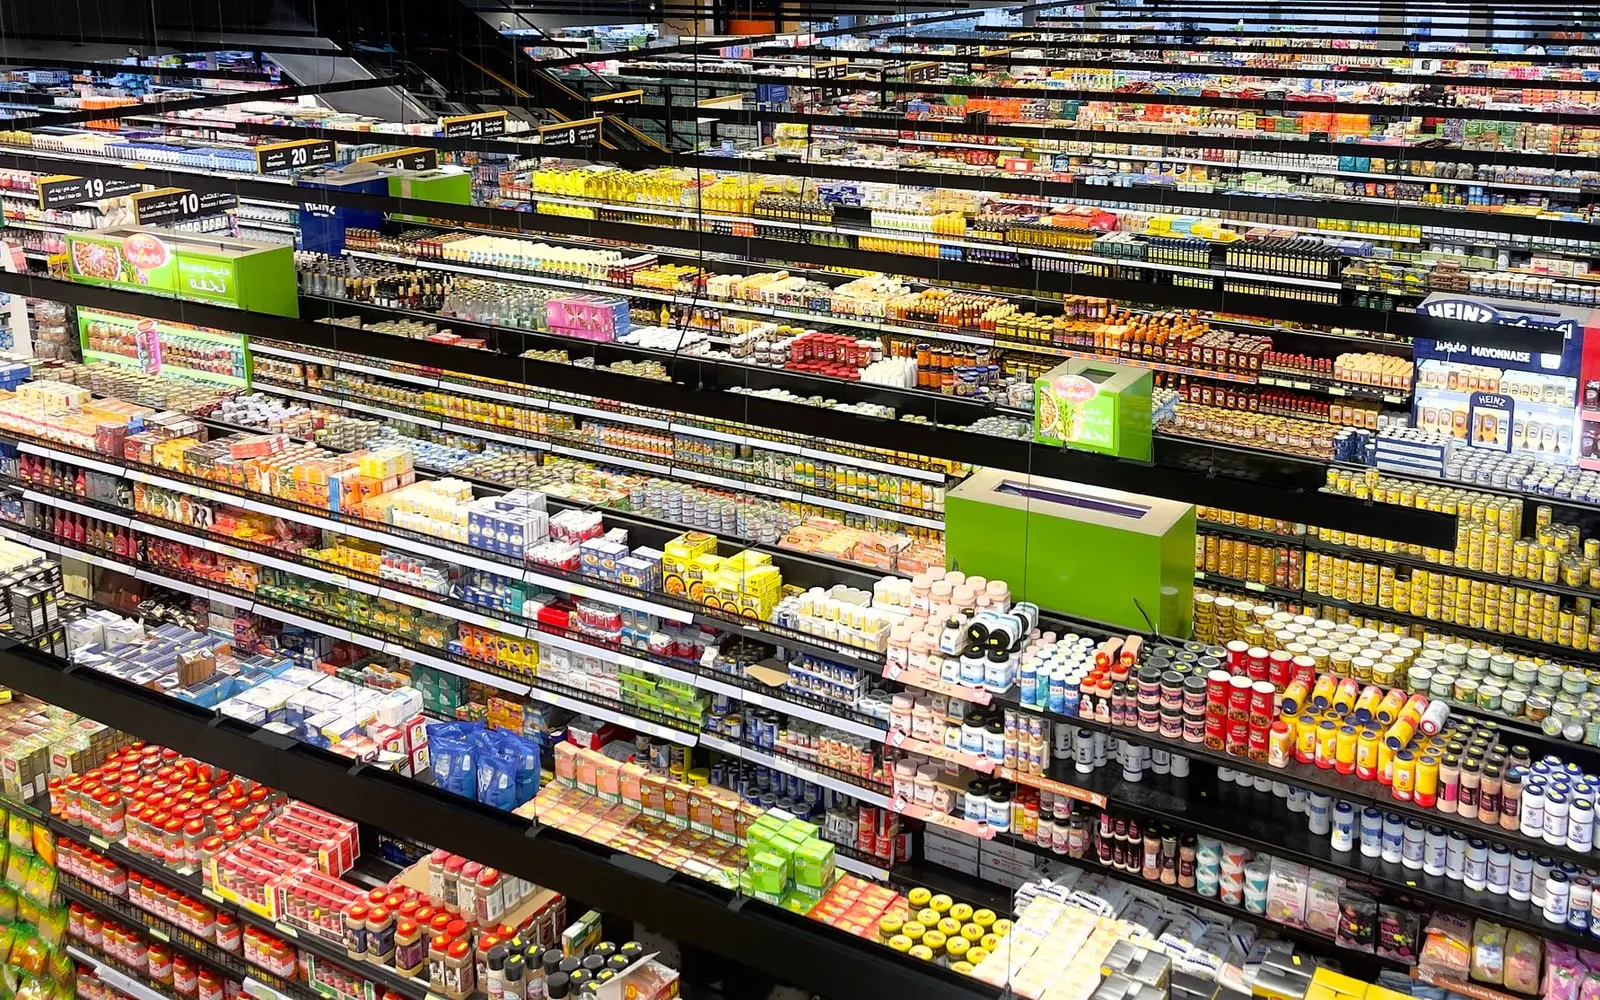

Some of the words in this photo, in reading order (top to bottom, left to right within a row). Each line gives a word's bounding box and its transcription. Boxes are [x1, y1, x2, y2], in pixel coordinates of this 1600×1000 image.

[470, 120, 482, 136] 21
[569, 128, 576, 144] 8
[291, 148, 307, 166] 20
[84, 178, 104, 198] 19
[180, 193, 198, 214] 10
[1427, 302, 1492, 323] HEINZ
[1471, 346, 1531, 362] MAYONNAISE
[1478, 395, 1506, 407] HEINZ
[1380, 923, 1400, 934] PINK
